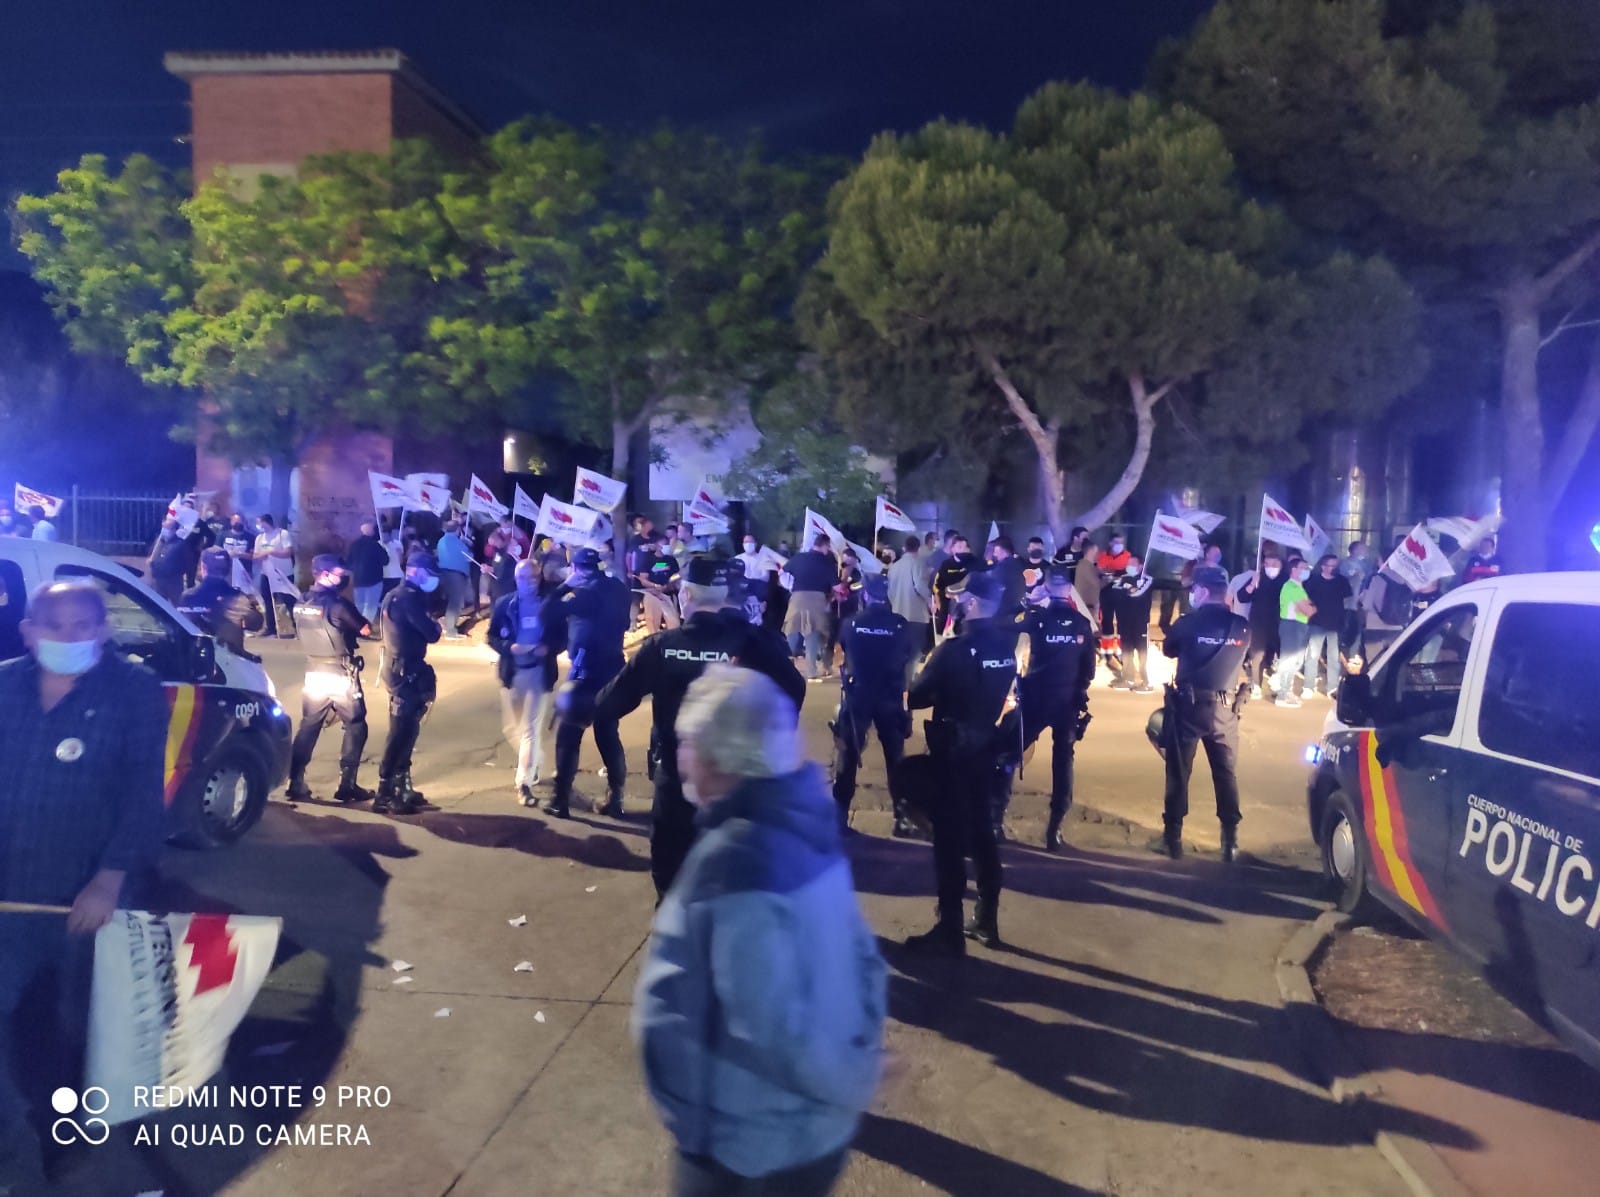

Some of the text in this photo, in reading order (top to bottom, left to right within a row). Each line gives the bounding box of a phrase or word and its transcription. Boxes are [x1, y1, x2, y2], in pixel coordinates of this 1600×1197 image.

[664, 648, 730, 662] POLICIA
[1467, 793, 1583, 853] CUERPO NACIONAL DE
